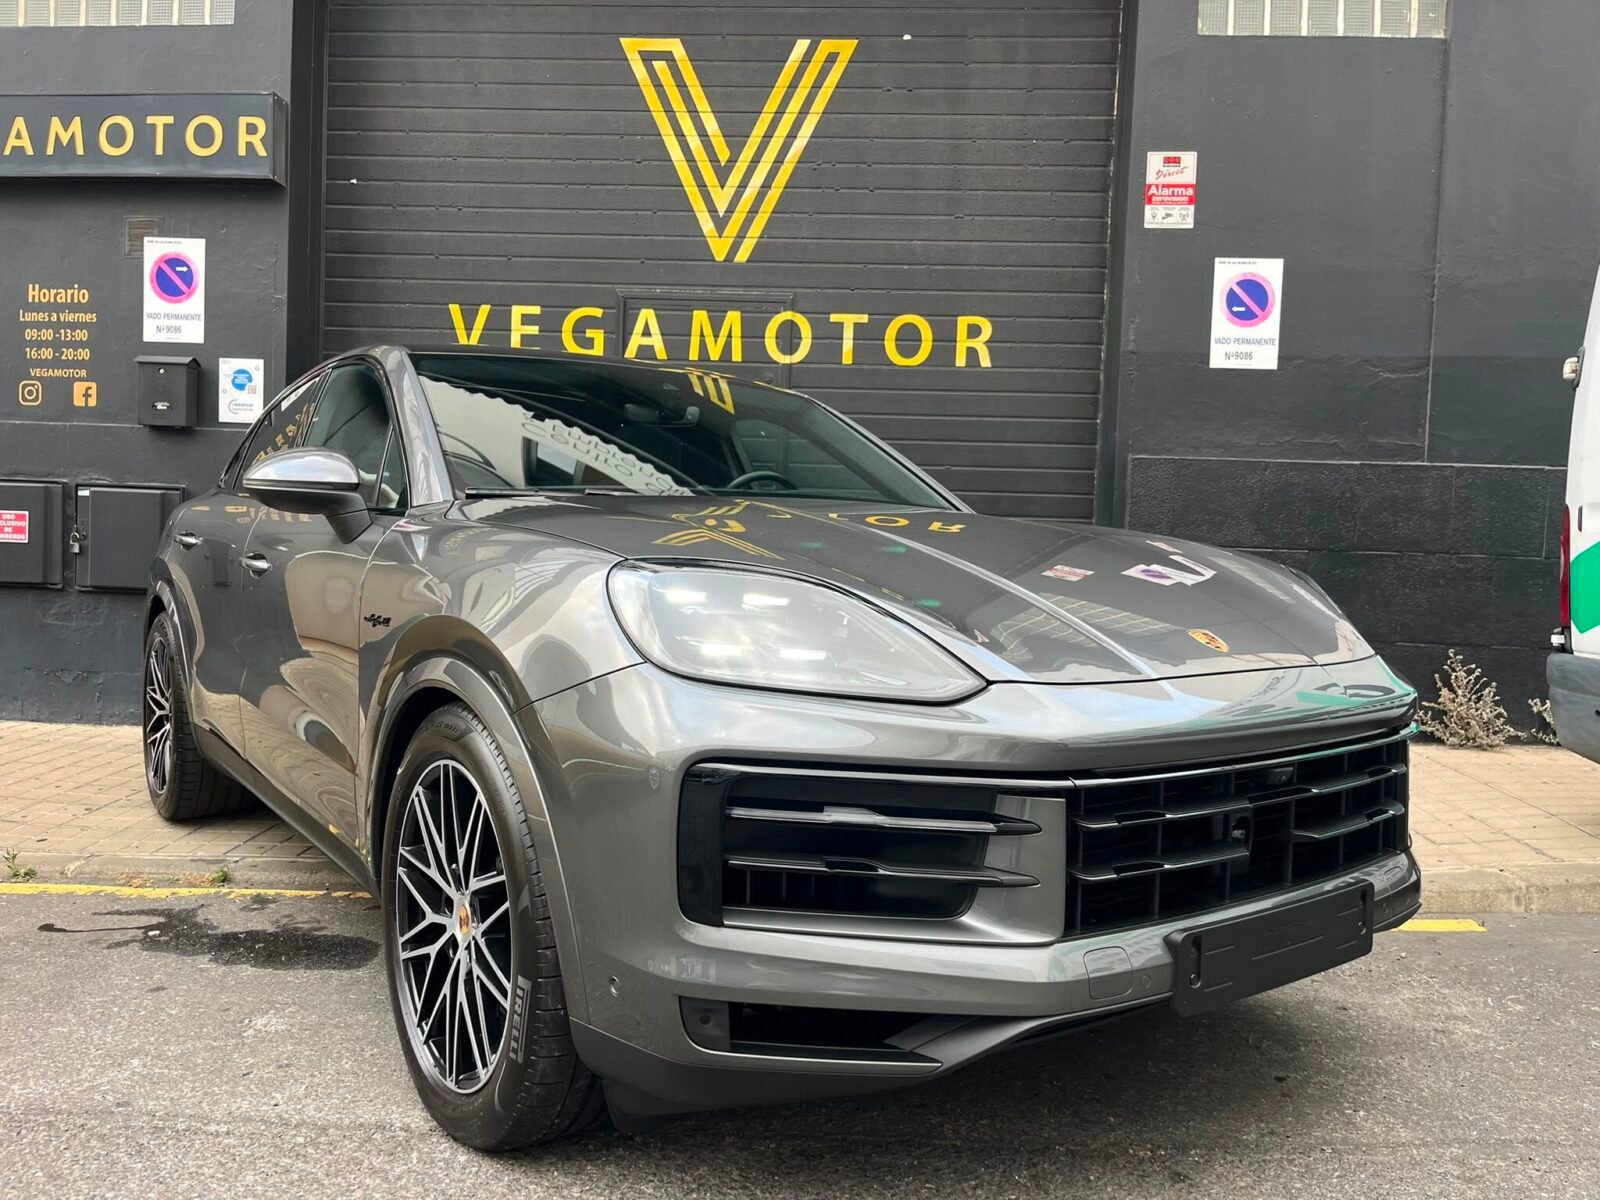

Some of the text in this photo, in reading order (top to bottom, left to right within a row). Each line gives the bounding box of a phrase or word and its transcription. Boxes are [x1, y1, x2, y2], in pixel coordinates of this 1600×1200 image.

[3, 114, 268, 157] AMOTOR
[1148, 185, 1193, 196] Alarma
[28, 283, 89, 304] Horario
[19, 309, 97, 323] Lunes a viernes
[146, 312, 202, 322] VADO PERMANENTE
[25, 328, 54, 341] 09:00
[448, 303, 993, 367] VEGAMOTOR
[1214, 337, 1276, 346] VADO PERMANENTE
[25, 347, 54, 360] 16:00
[61, 347, 90, 361] 20:00
[29, 367, 87, 378] VEGAMOTOR
[509, 975, 532, 1064] PIRELLI
